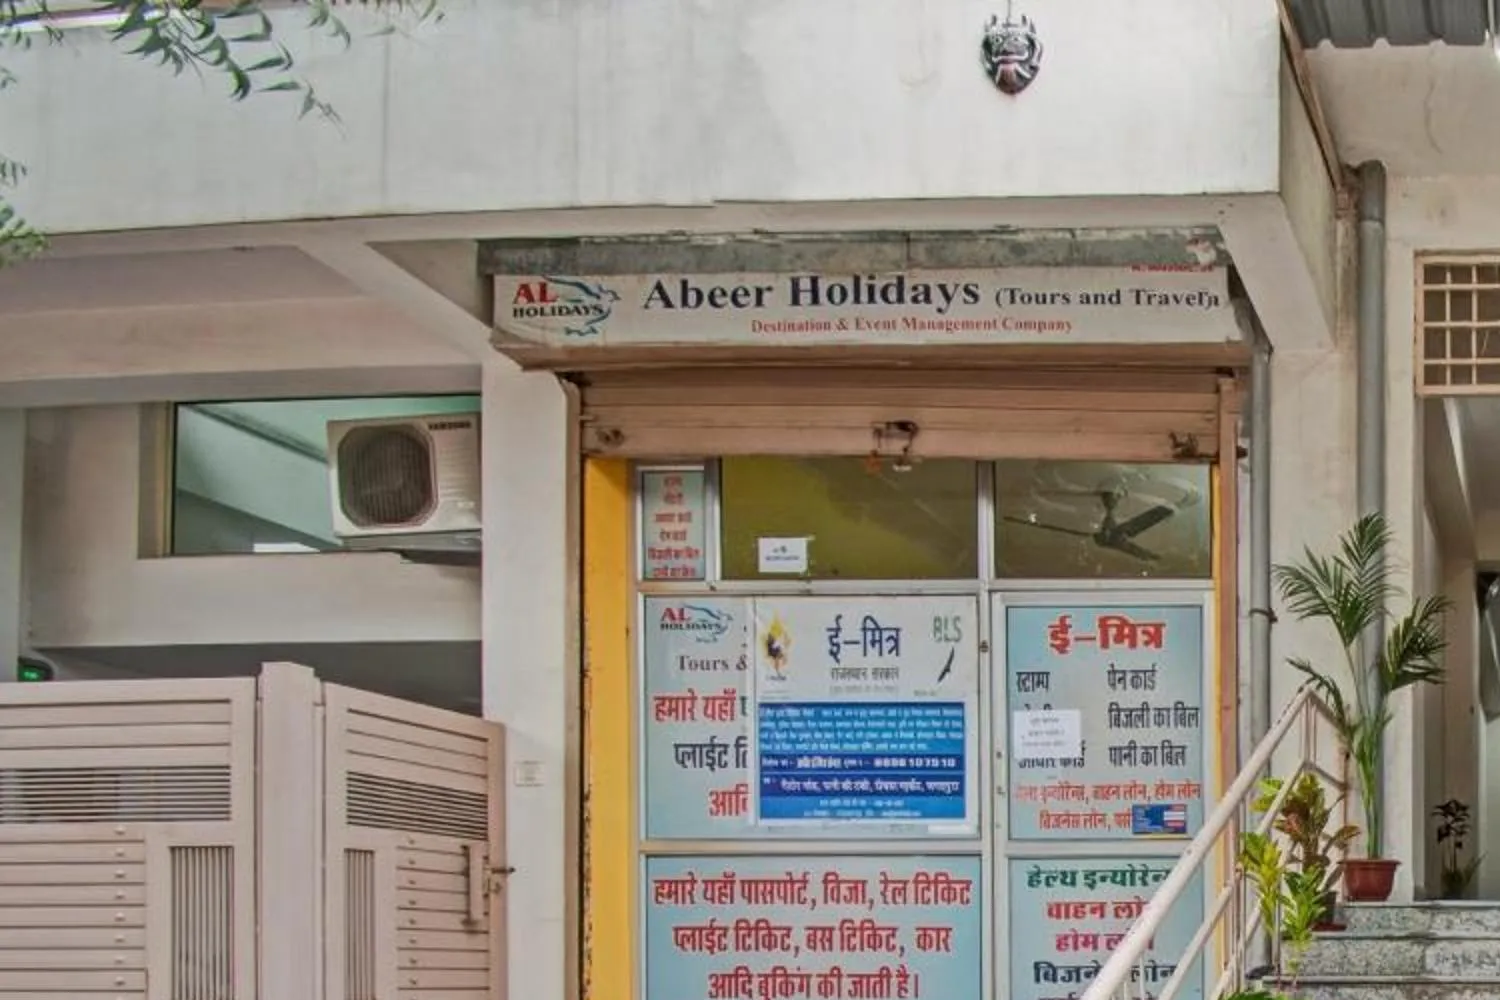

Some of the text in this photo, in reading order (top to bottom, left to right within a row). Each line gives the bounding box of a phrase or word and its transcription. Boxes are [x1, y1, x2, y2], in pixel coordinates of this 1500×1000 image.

[513, 282, 558, 305] AL
[644, 278, 774, 309] Abeer
[788, 273, 981, 313] Holidays
[995, 287, 1071, 308] (Tours
[1079, 288, 1121, 306] and
[513, 304, 604, 318] HOLIDAYS
[752, 317, 1073, 334] Destination & Event Management Company
[659, 607, 692, 622] AL
[676, 654, 729, 671] Tours
[1129, 663, 1157, 691] कार्ड
[653, 689, 698, 721] हमारे
[1108, 701, 1200, 729] बिजली का बिल
[1109, 739, 1188, 768] पानी का बिल
[652, 871, 698, 904] हमारे
[740, 871, 817, 910] पासपोर्ट,
[822, 871, 875, 910] विजा,
[880, 871, 909, 904] रेल
[913, 871, 973, 905] टिकिट
[1046, 900, 1108, 920] वाहन
[672, 917, 953, 957] प्लाईट टिकिट, बस टिकिट, कार
[1055, 929, 1100, 952] होम
[708, 965, 753, 1000] आदि
[816, 965, 843, 1000] की
[847, 965, 892, 999] जाती
